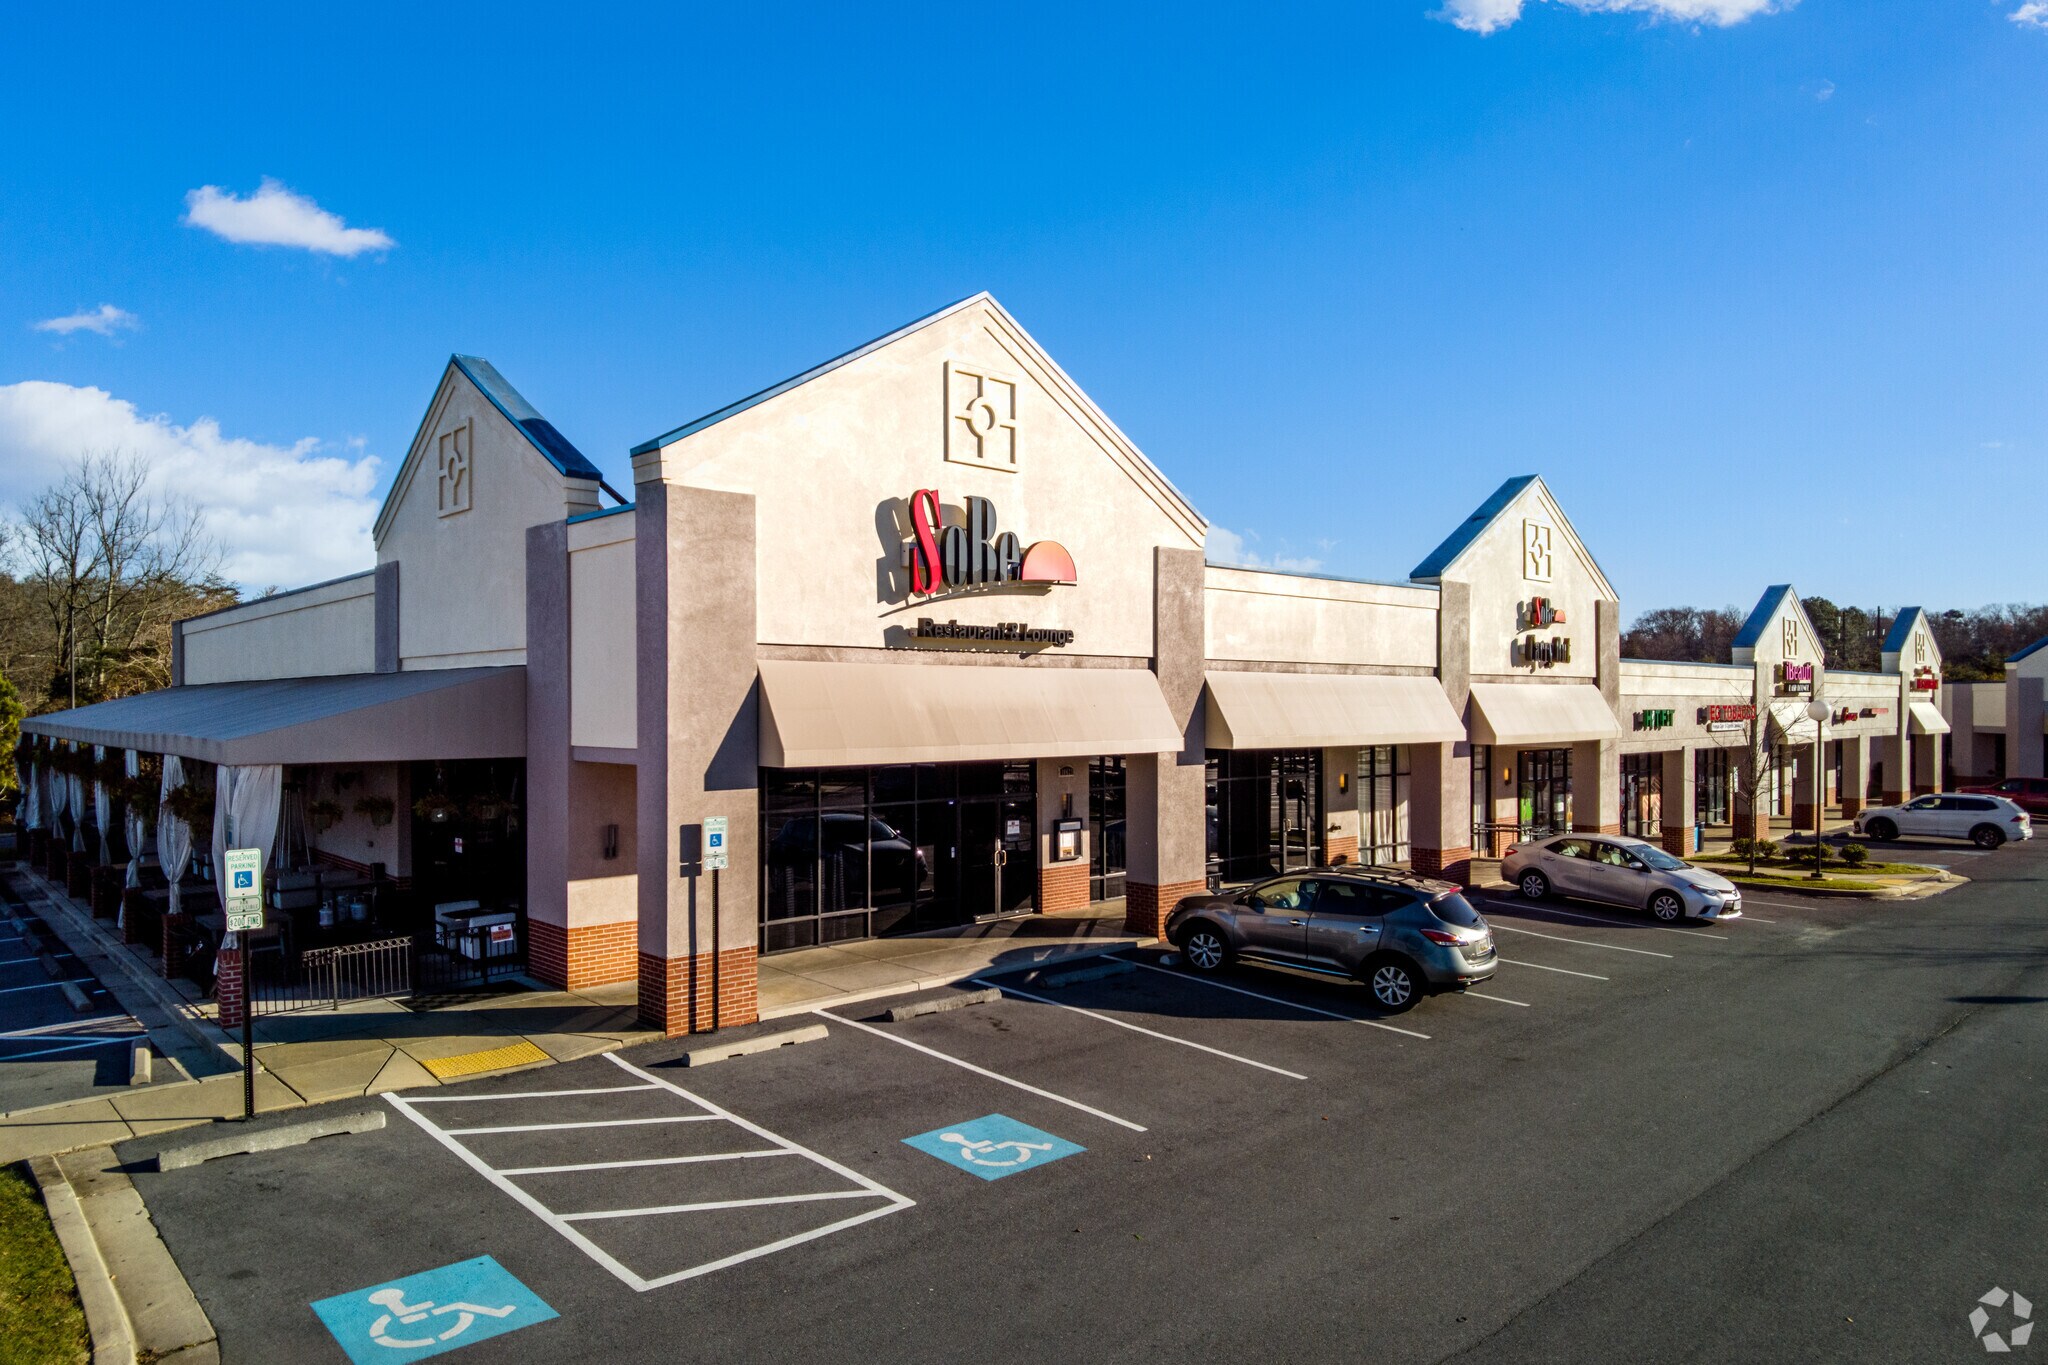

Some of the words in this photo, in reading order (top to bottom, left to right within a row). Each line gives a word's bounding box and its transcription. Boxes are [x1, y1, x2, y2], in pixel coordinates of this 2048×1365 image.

[918, 618, 1006, 640] Restaurant
[1006, 622, 1020, 641] &
[1019, 624, 1074, 647] Lounge
[1722, 705, 1757, 720] TOBACCO
[229, 917, 246, 927] $200
[247, 915, 260, 925] FINE
